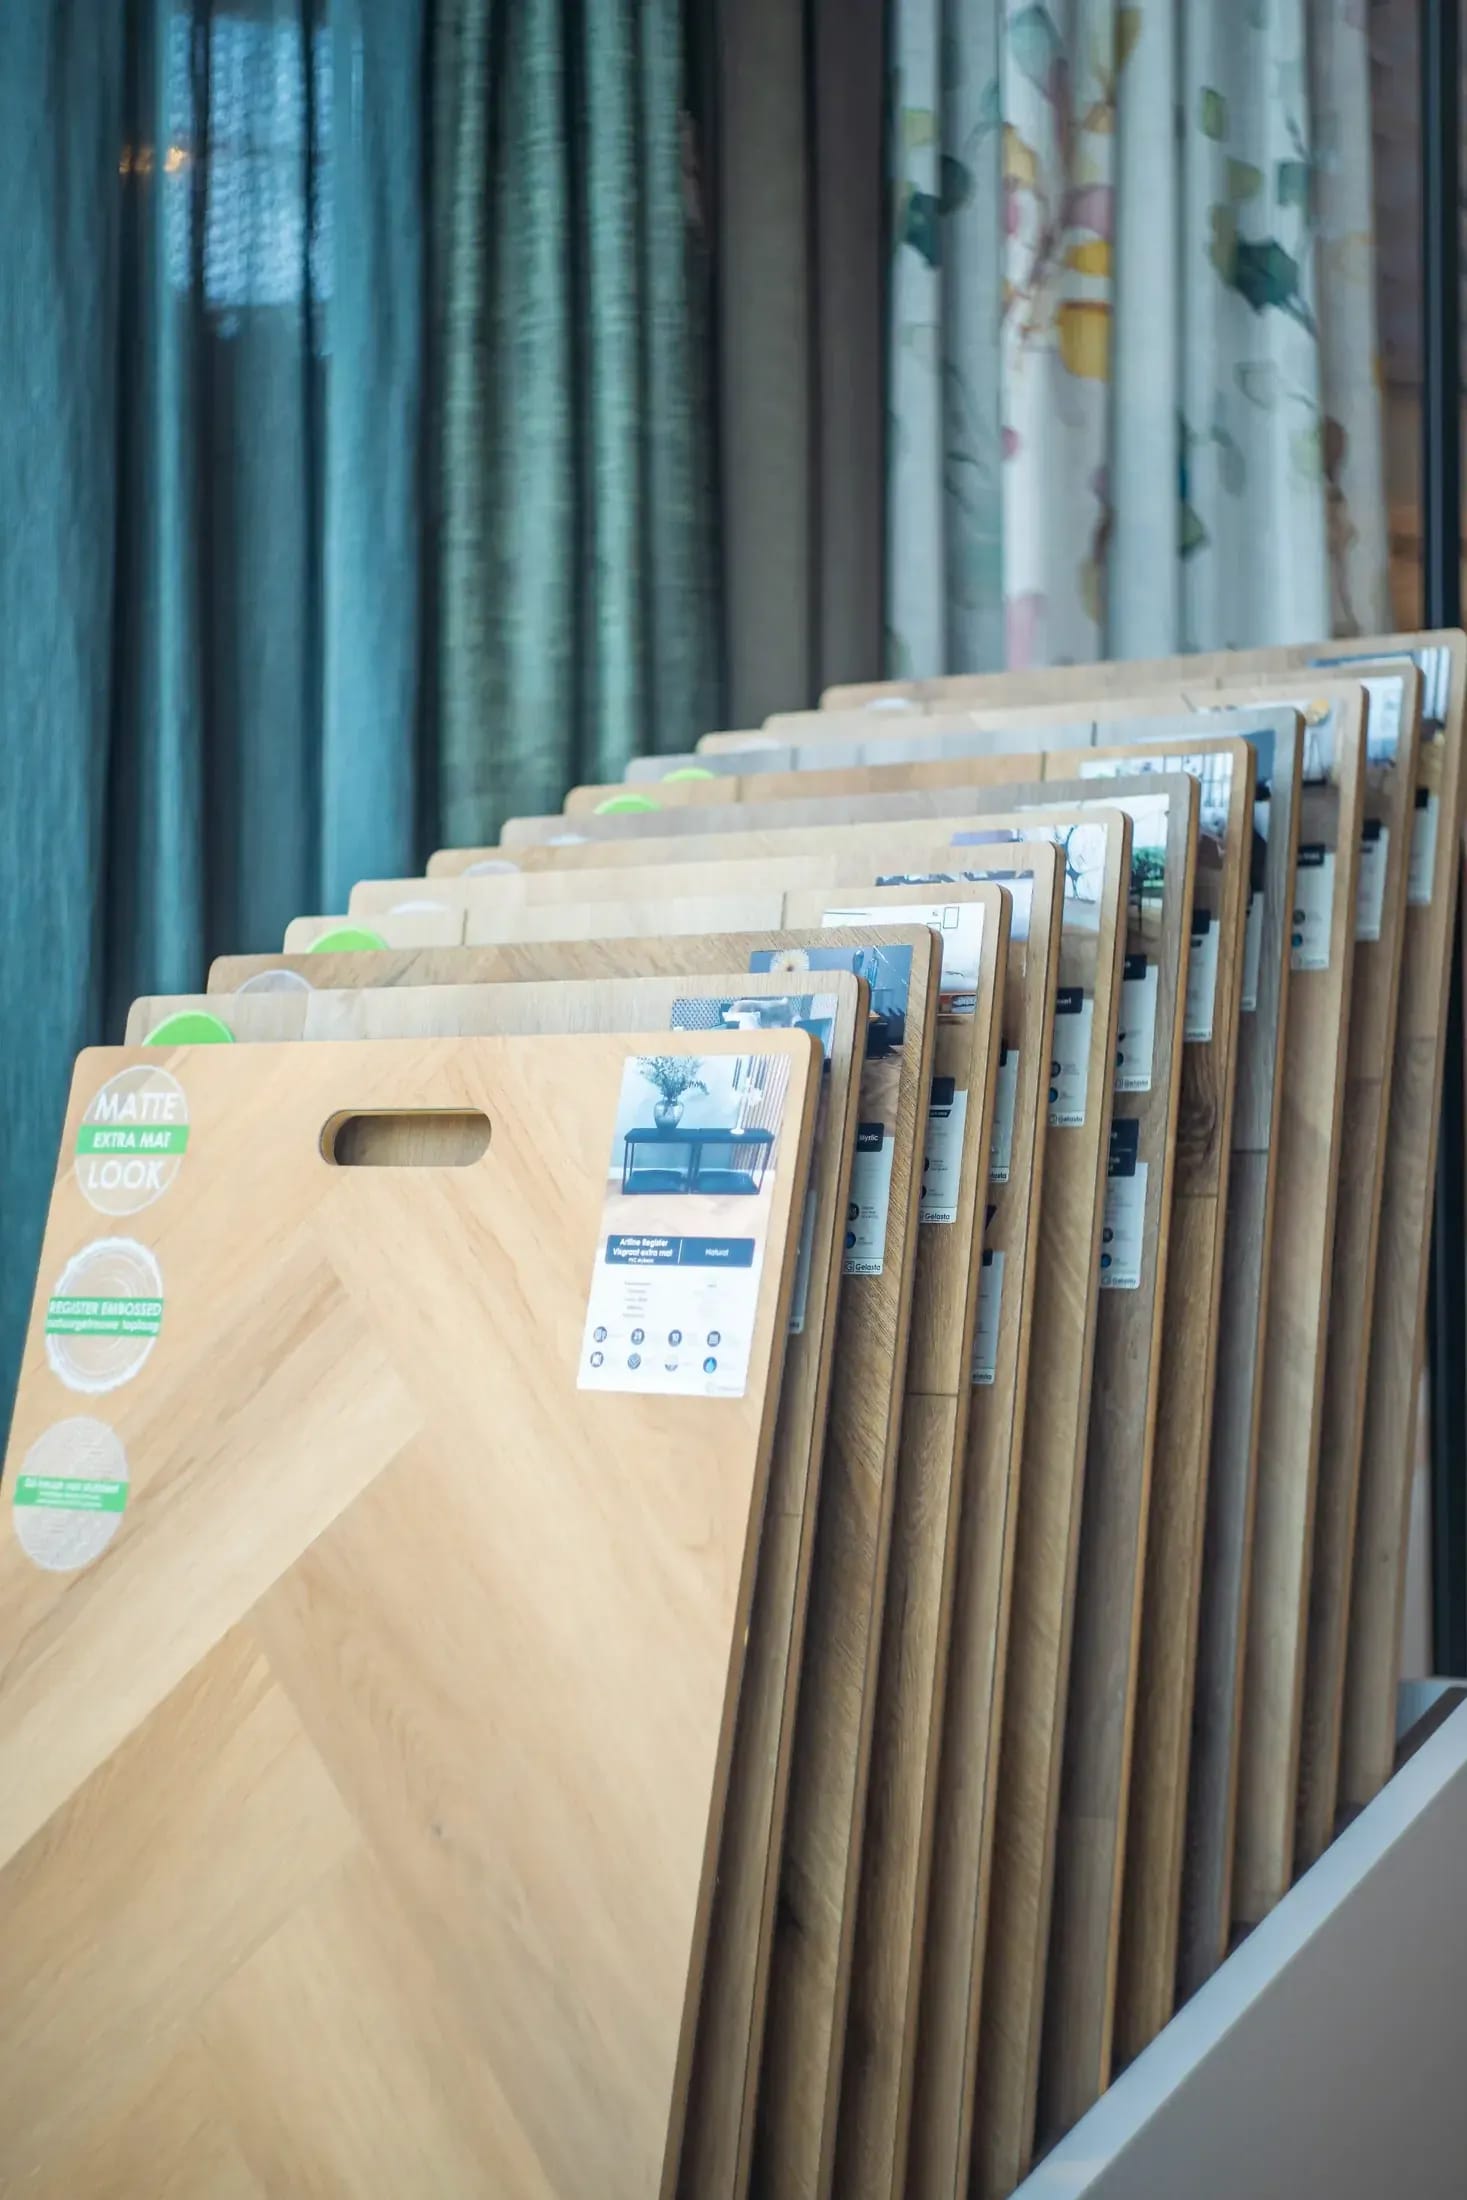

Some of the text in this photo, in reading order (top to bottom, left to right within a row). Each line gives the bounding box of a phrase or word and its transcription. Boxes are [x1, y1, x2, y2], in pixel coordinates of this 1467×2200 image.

[94, 1092, 179, 1121] MATTE
[92, 1131, 172, 1149] EXTRA MAT
[88, 1160, 164, 1190] LOOK
[925, 1212, 950, 1220] Gelasta
[855, 1263, 881, 1271] Gelasta
